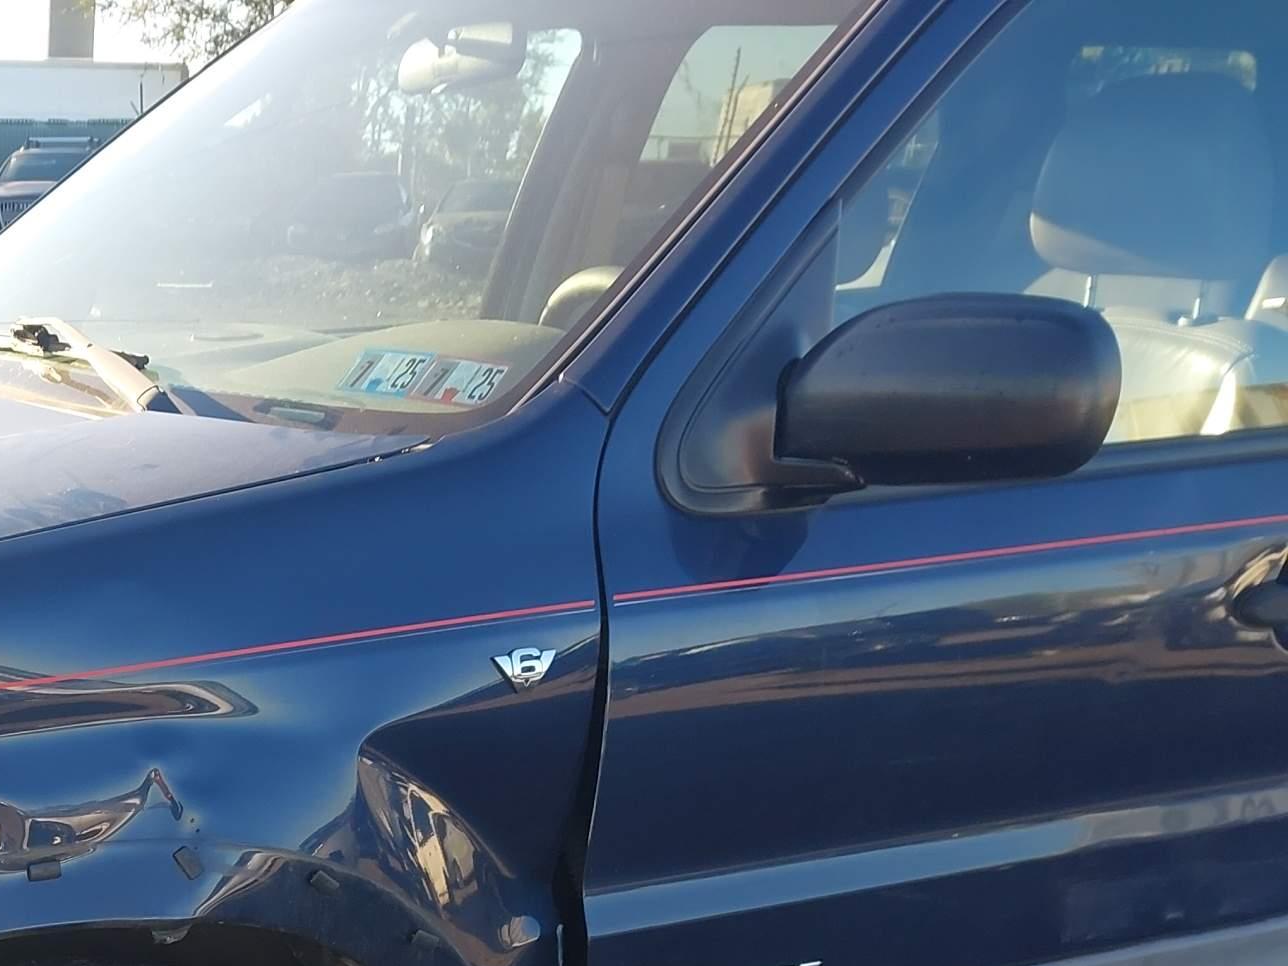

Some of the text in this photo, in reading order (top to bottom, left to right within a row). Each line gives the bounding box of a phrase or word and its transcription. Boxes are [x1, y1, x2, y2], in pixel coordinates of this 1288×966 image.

[390, 357, 428, 389] 25
[467, 367, 505, 401] 25
[492, 646, 558, 688] V6
